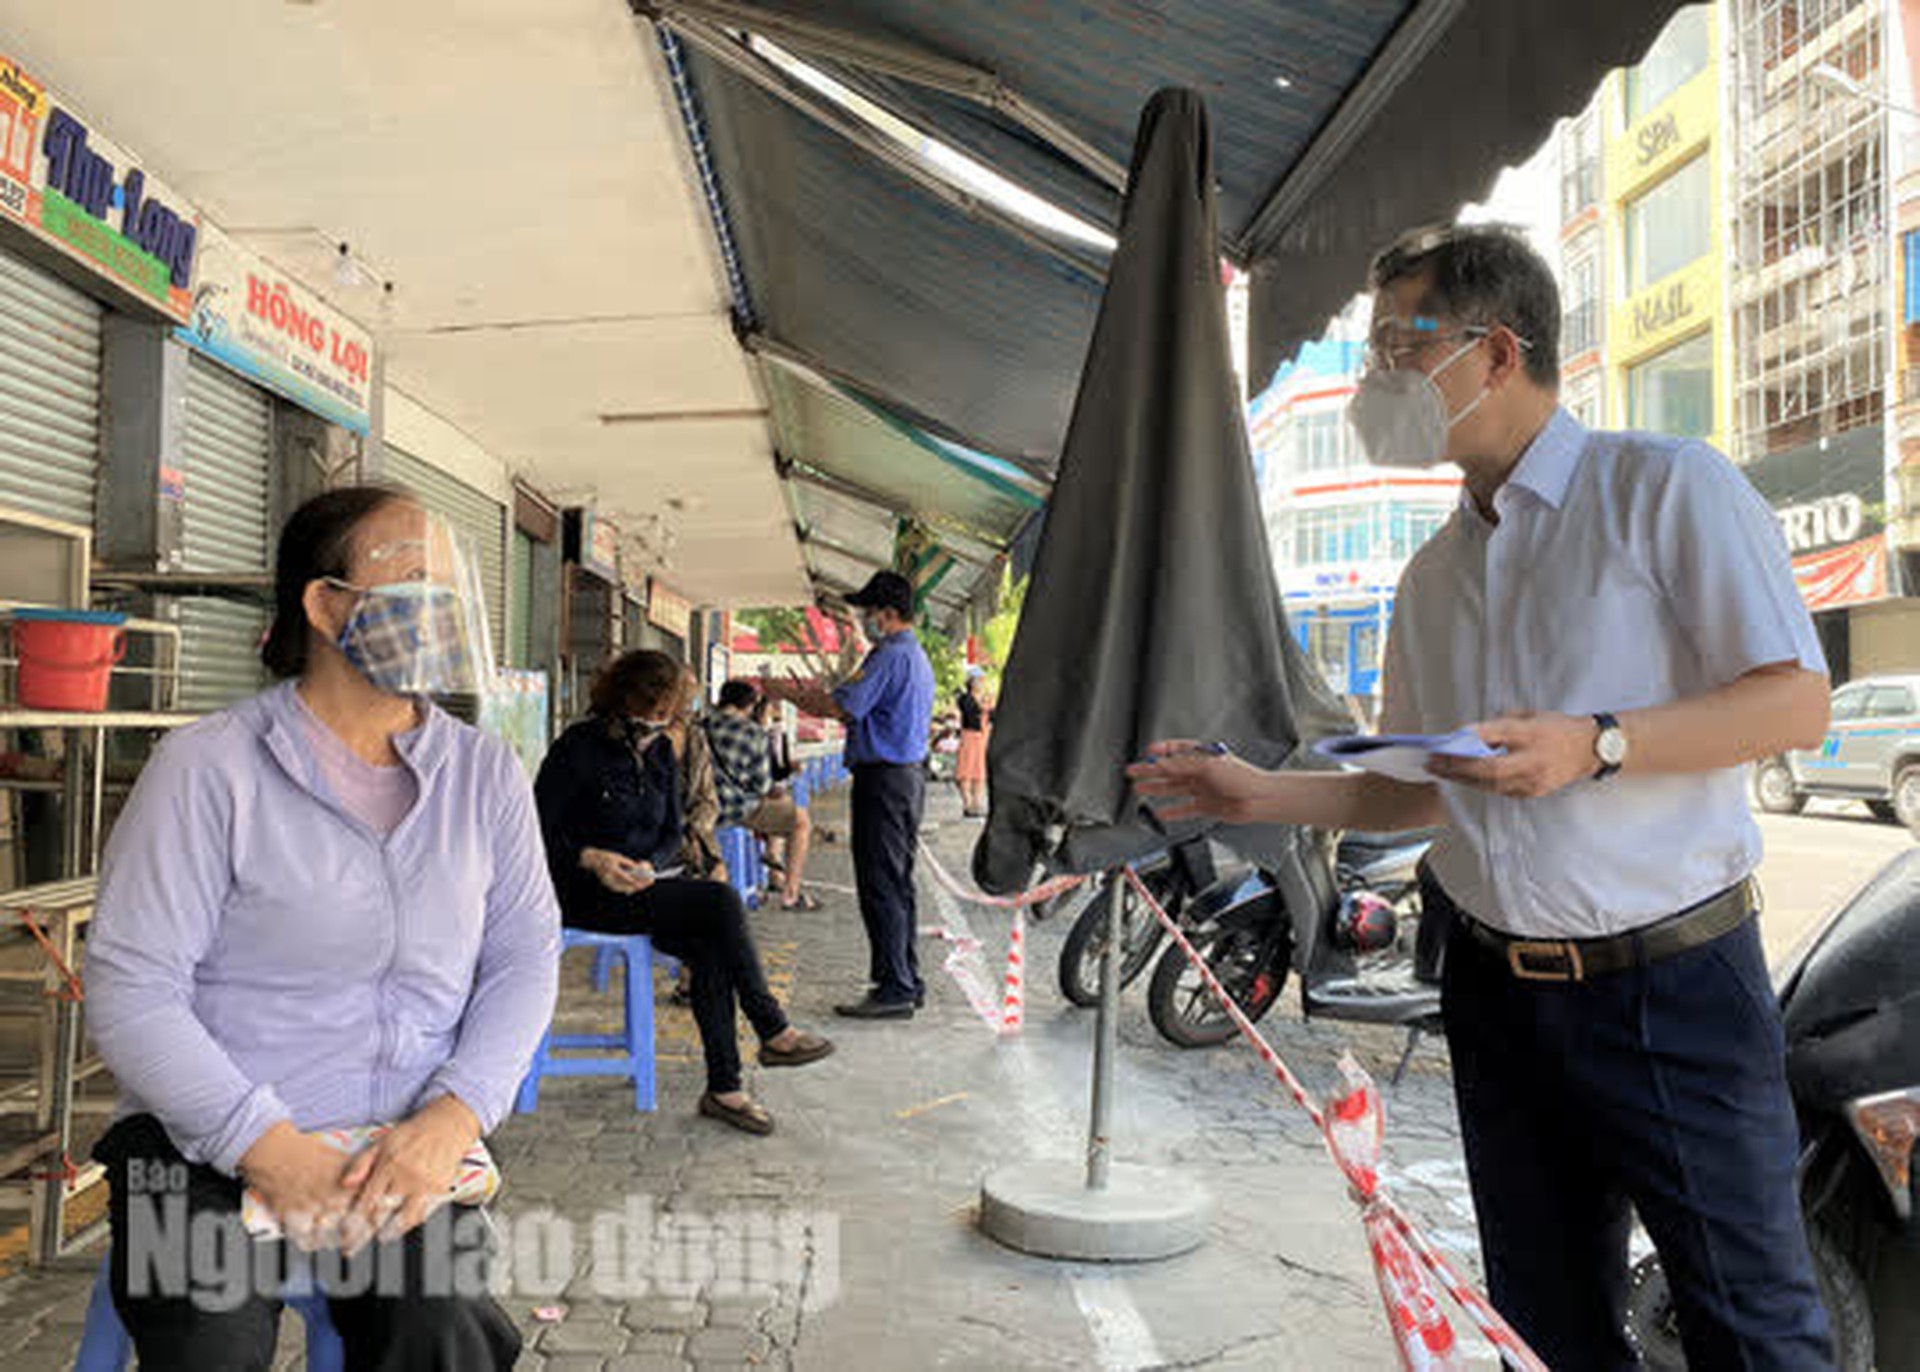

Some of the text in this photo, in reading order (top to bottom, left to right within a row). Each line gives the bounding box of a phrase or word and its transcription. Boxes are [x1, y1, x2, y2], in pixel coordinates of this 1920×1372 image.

[1636, 112, 1682, 166] SPA
[1630, 281, 1694, 331] NAIL
[1776, 493, 1861, 552] RTO
